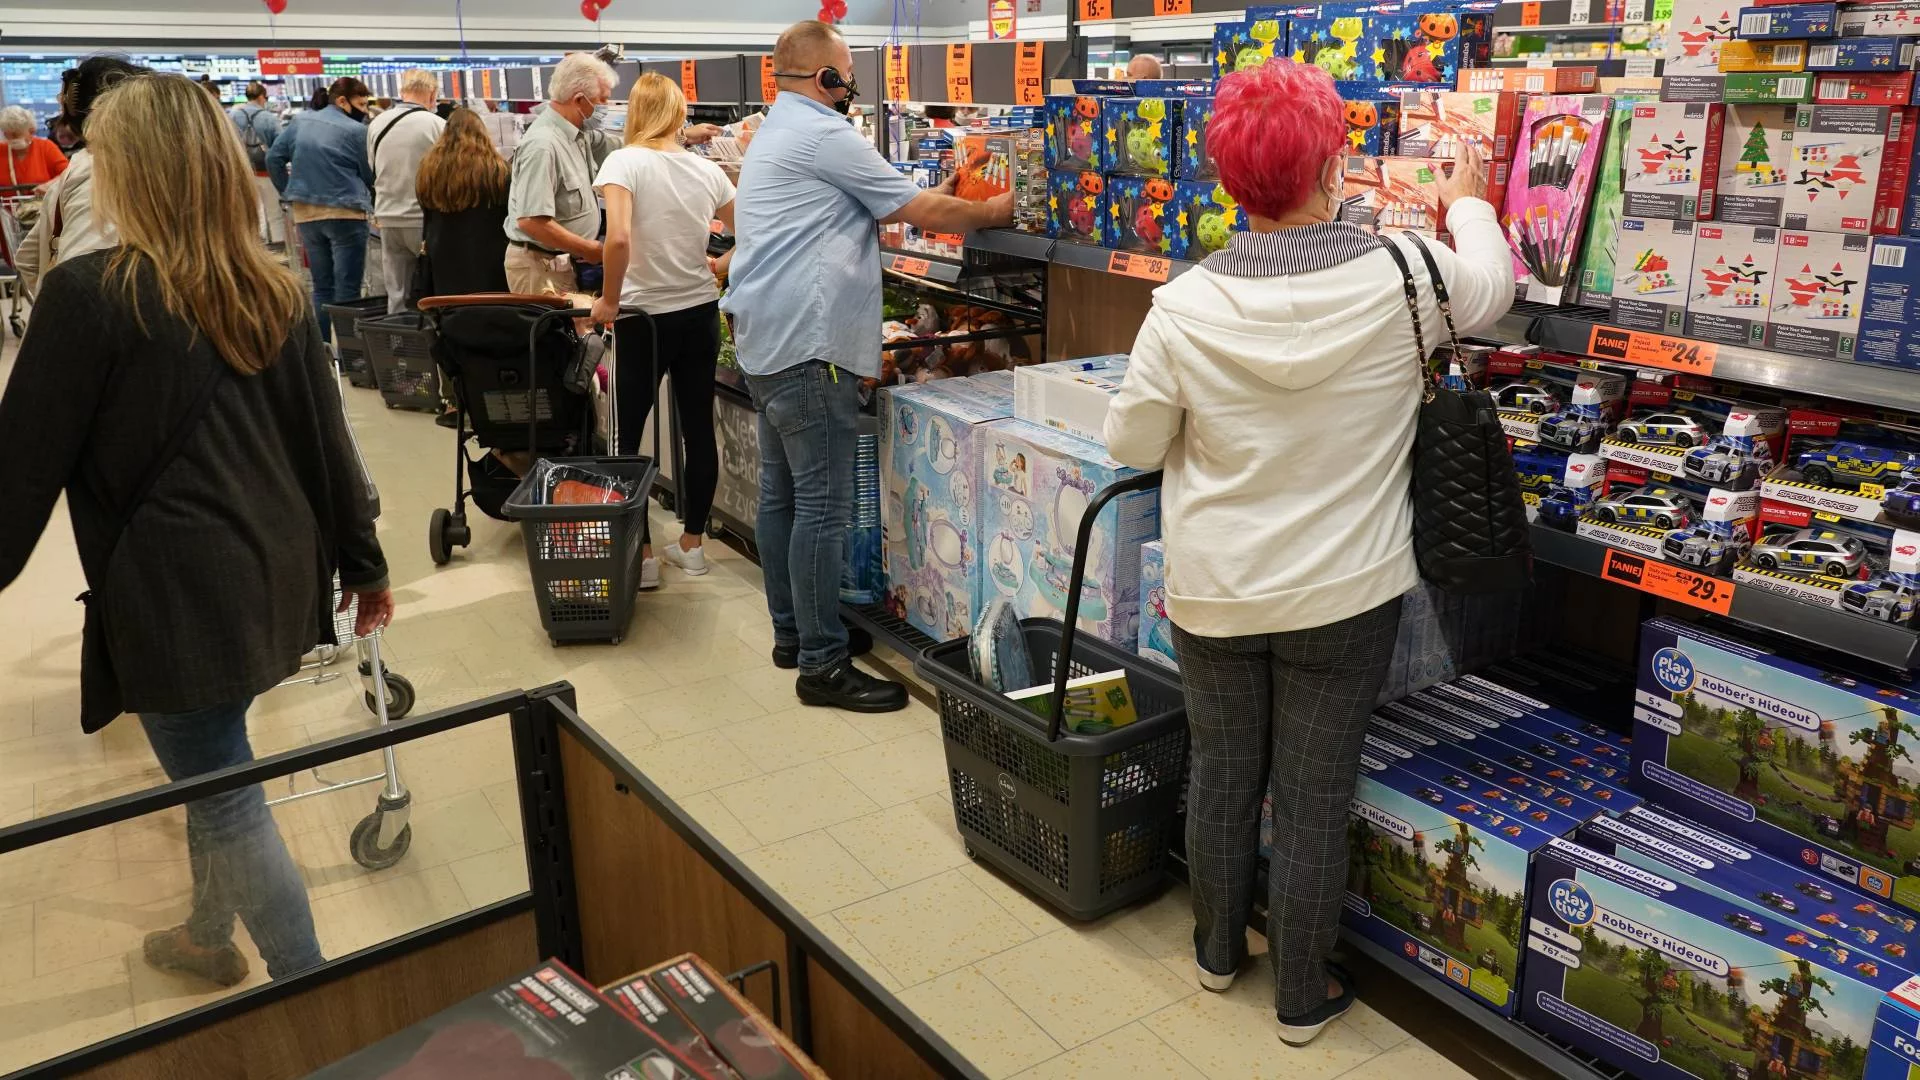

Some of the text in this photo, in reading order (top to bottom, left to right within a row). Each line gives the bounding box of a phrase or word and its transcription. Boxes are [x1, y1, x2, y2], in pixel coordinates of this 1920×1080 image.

[1087, 1, 1104, 16] 15.-
[1623, 221, 1633, 229] 22
[1701, 229, 1710, 237] 18
[1785, 236, 1795, 244] 18
[1596, 336, 1628, 351] TANIEJ
[1672, 342, 1712, 366] 24.-
[1611, 450, 1629, 460] AUDI
[1650, 459, 1679, 471] POLICE
[1777, 489, 1858, 512] SPECIAL FORCES
[1762, 507, 1786, 515] DICKIE
[1787, 510, 1808, 518] TOYS
[1588, 529, 1606, 539] AUDI
[1608, 533, 1620, 541] RS
[1629, 539, 1658, 553] POLICE
[1611, 559, 1643, 578] TANIEJ
[1688, 578, 1730, 603] 29.-
[1748, 577, 1771, 588] AUDI
[1774, 584, 1788, 594] RS
[1799, 591, 1834, 606] POLICE
[1658, 656, 1690, 678] Play
[1659, 669, 1687, 688] tive
[1439, 683, 1516, 717] Robber's Hideout
[1466, 674, 1544, 708] Robber's Hideout
[1702, 677, 1811, 725] Robber's Hideout
[1455, 707, 1493, 727] Hideout
[1647, 713, 1663, 726] 767
[1431, 718, 1470, 739] Hideout
[1368, 736, 1406, 759] Hideout
[1368, 808, 1407, 834] Hideout
[1600, 818, 1653, 845] Robber's
[1654, 840, 1706, 867] Hideout
[1637, 809, 1690, 835] Robber's
[1691, 831, 1743, 858] Hideout
[1557, 840, 1611, 867] Robber's
[1613, 862, 1668, 889] Hideout
[1555, 886, 1589, 911] Play
[1555, 899, 1587, 921] tive
[1542, 944, 1560, 958] 767
[1601, 912, 1719, 970] Robber's Hideout
